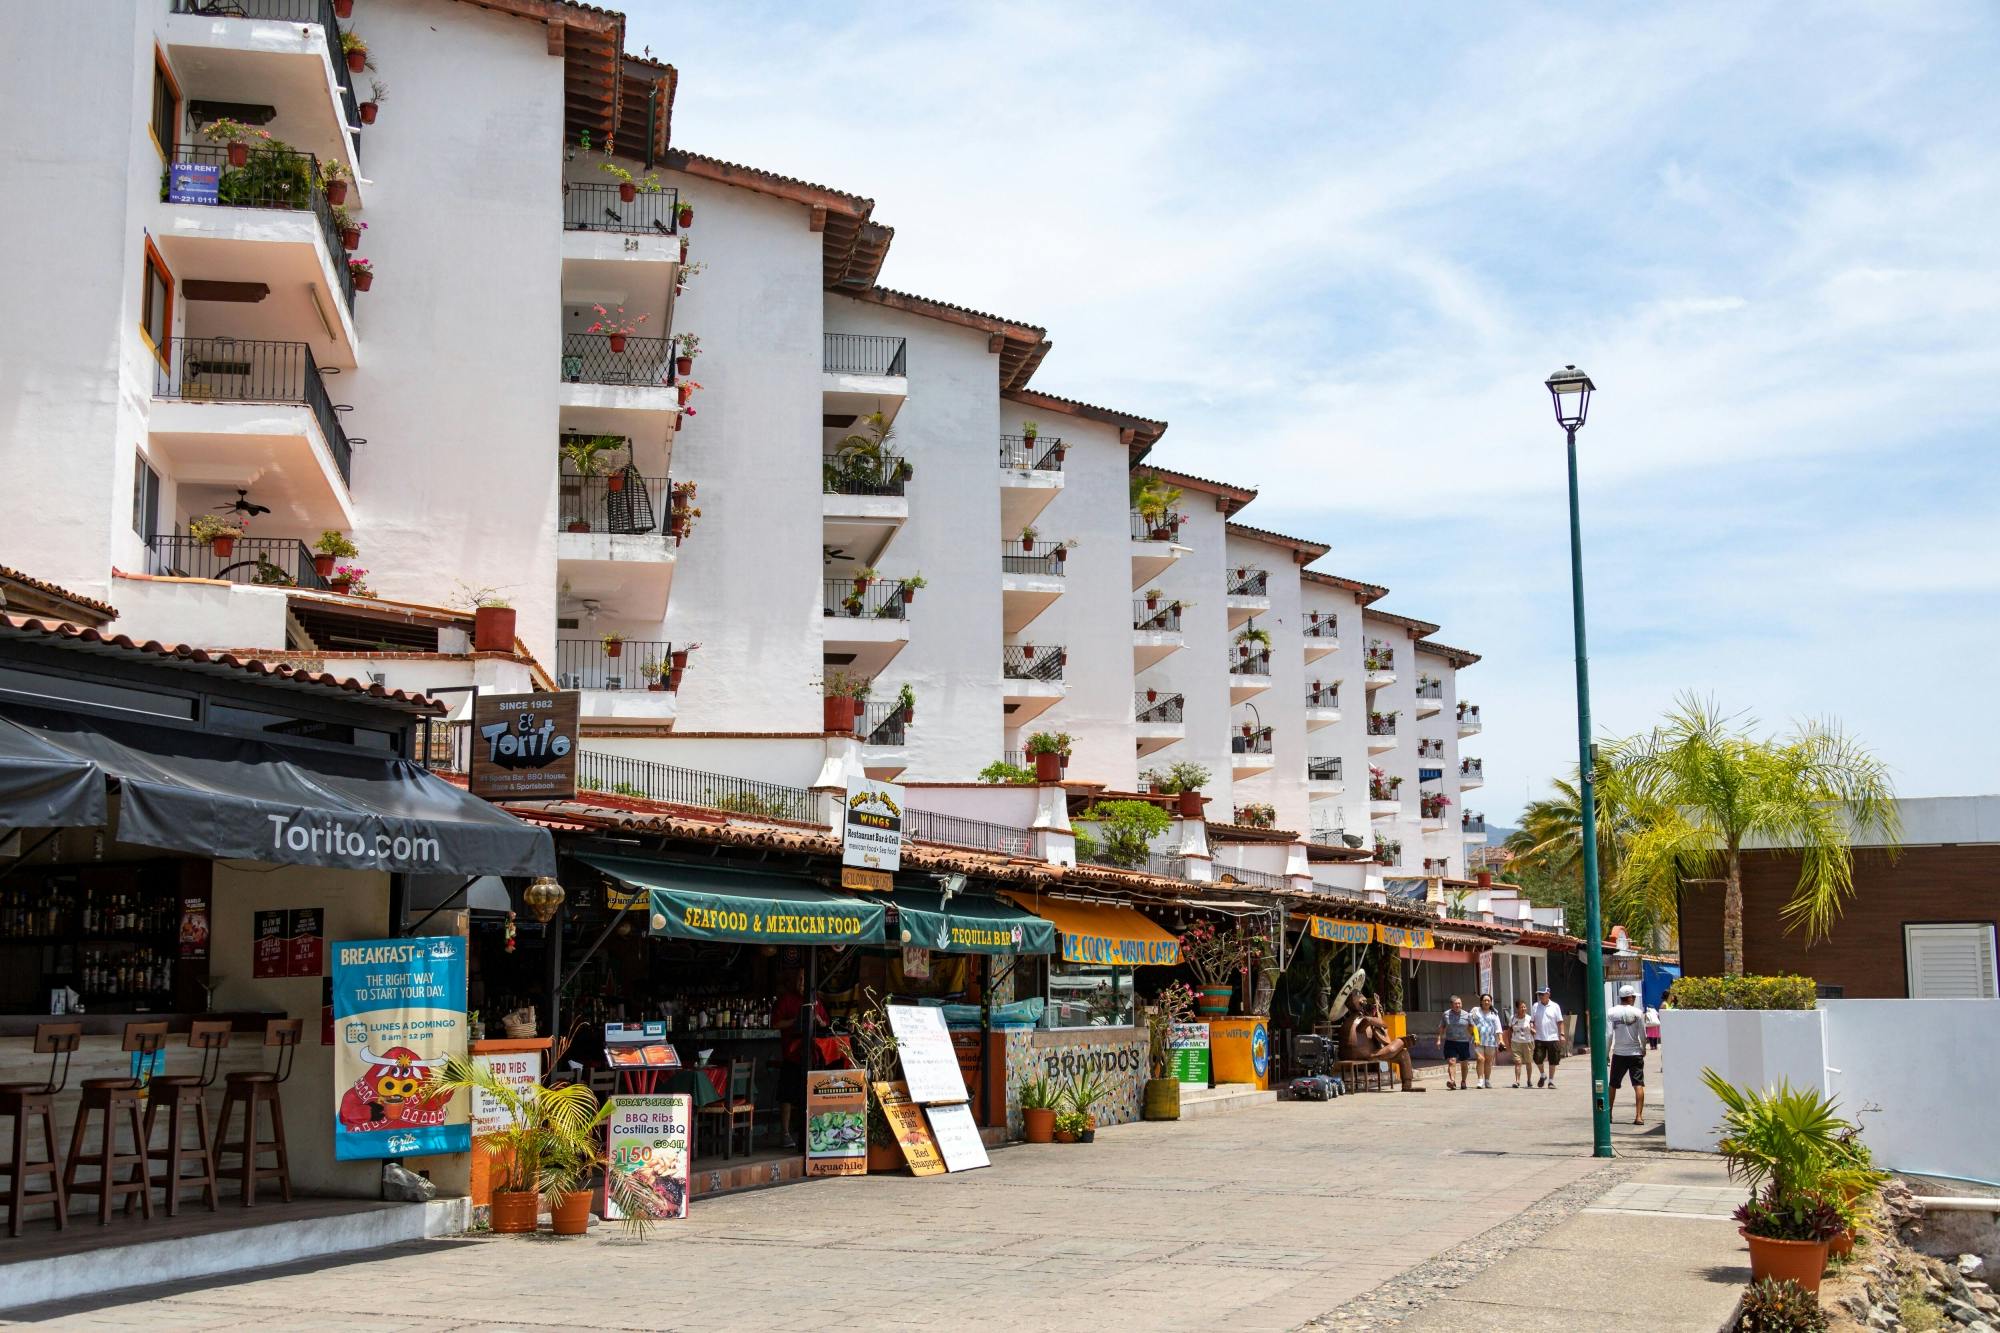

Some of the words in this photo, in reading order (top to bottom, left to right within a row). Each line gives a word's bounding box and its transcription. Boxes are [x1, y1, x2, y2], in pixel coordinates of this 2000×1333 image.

[197, 196, 217, 204] 0111
[499, 701, 528, 711] SINCE
[530, 700, 553, 709] 1982
[518, 713, 535, 731] El
[480, 719, 571, 762] Torito
[527, 773, 543, 781] BBQ
[860, 813, 891, 828] WINGS
[267, 814, 441, 863] Torito.com
[847, 828, 876, 842] Restaurant
[876, 833, 885, 843] Bar
[889, 836, 899, 846] Grill
[684, 907, 748, 931] SEAFOOD
[753, 914, 762, 931] &
[766, 915, 825, 934] MEXICAN
[828, 916, 861, 934] FOOD
[951, 927, 992, 946] TEQUILA
[993, 931, 1012, 946] BAR
[1317, 919, 1368, 941] BRANDO'S
[1062, 933, 1080, 961] WE
[1081, 935, 1112, 962] COOK
[1119, 940, 1146, 963] YOUR
[341, 945, 415, 966] BREAKFAST
[416, 949, 425, 958] BY
[365, 974, 384, 987] THE
[385, 973, 411, 986] RIGHT
[412, 972, 435, 985] WAY
[355, 989, 368, 1001] TO
[369, 987, 397, 1000] START
[399, 986, 425, 999] YOUR
[426, 985, 446, 998] DAY.
[370, 1022, 400, 1032] LUNES
[402, 1021, 409, 1030] A
[411, 1019, 456, 1029] DOMINGO
[420, 1032, 434, 1042] pm
[509, 1061, 527, 1074] RIBS
[615, 1098, 651, 1107] TODAY'S
[652, 1097, 684, 1107] SPECIAL
[625, 1113, 649, 1123] BBQ
[652, 1113, 674, 1123] Ribs
[891, 1109, 917, 1120] Whole
[613, 1124, 659, 1134] Costillas
[662, 1124, 686, 1134] BBQ
[900, 1119, 918, 1129] Fish
[611, 1146, 653, 1163] $150
[913, 1149, 930, 1159] Red
[812, 1160, 863, 1173] Aguachile
[911, 1158, 941, 1170] Snapper
